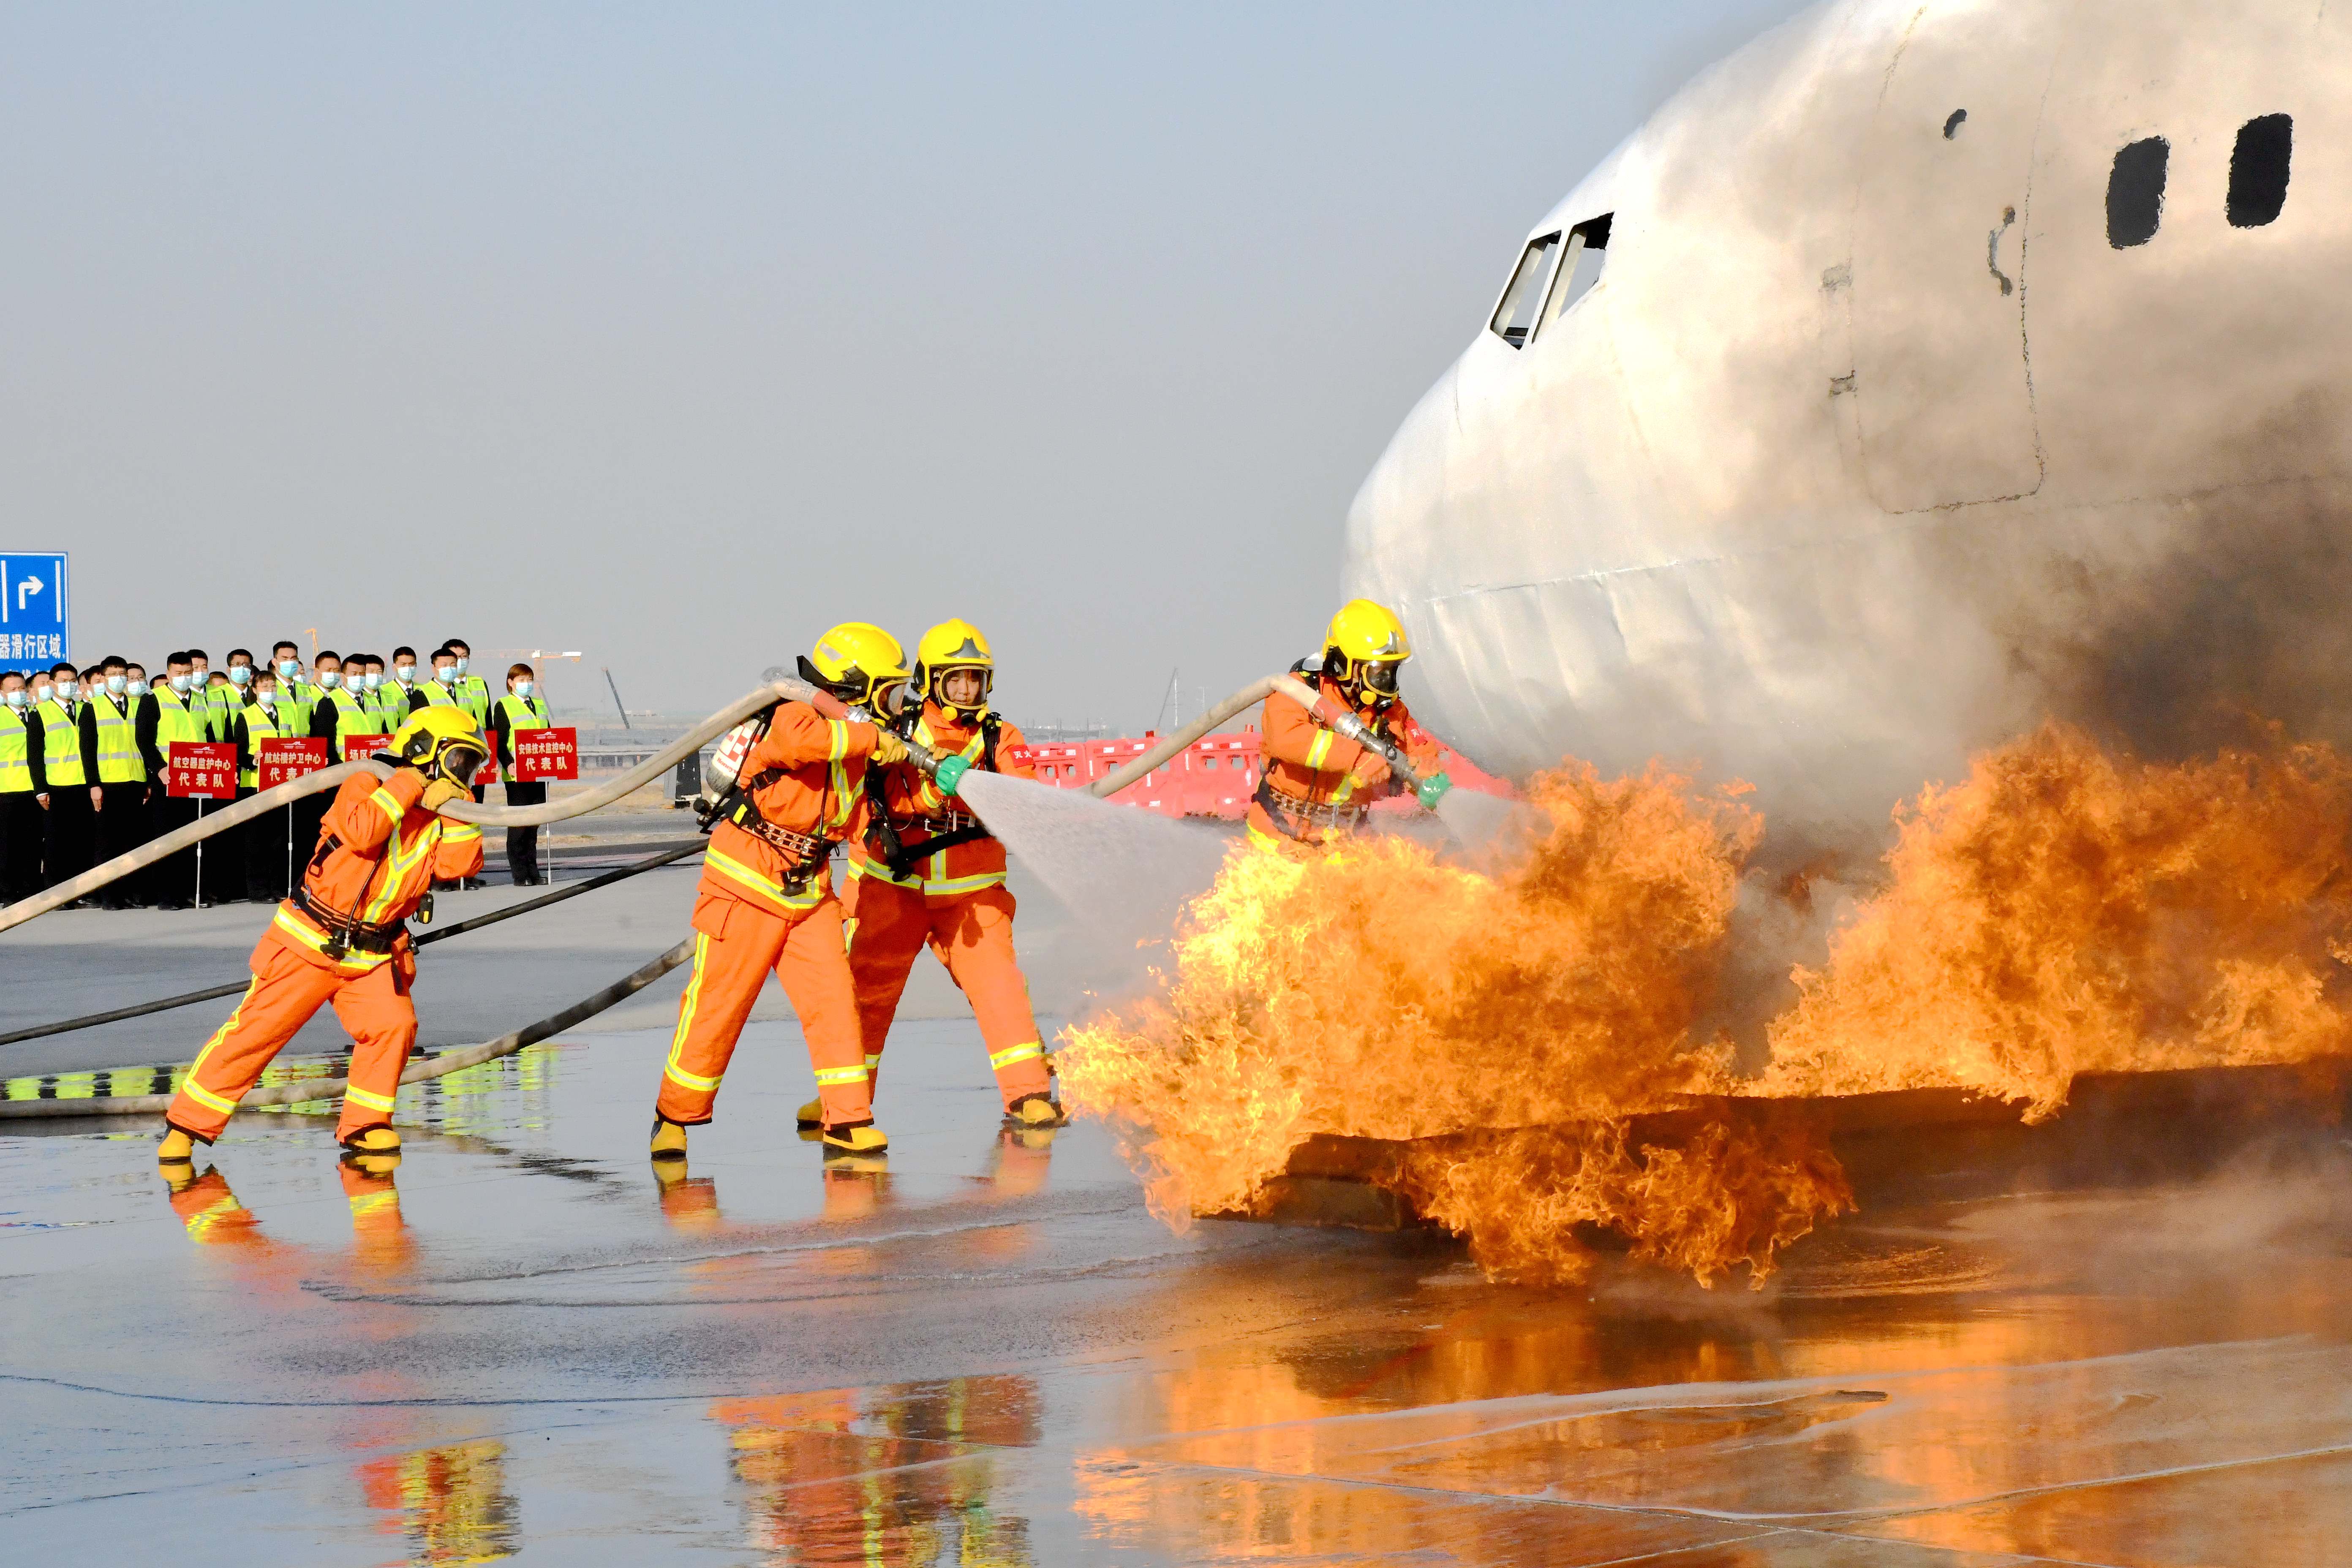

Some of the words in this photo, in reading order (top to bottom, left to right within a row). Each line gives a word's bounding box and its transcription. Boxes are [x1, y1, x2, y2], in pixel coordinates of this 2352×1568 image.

[518, 742, 573, 755] 安保技术监控中心
[1013, 750, 1032, 759] 灭火
[173, 756, 231, 770] 航空器监护中心
[264, 751, 321, 765] 航站楼护卫中心
[525, 756, 567, 771] 代表队
[179, 772, 224, 787] 代表队
